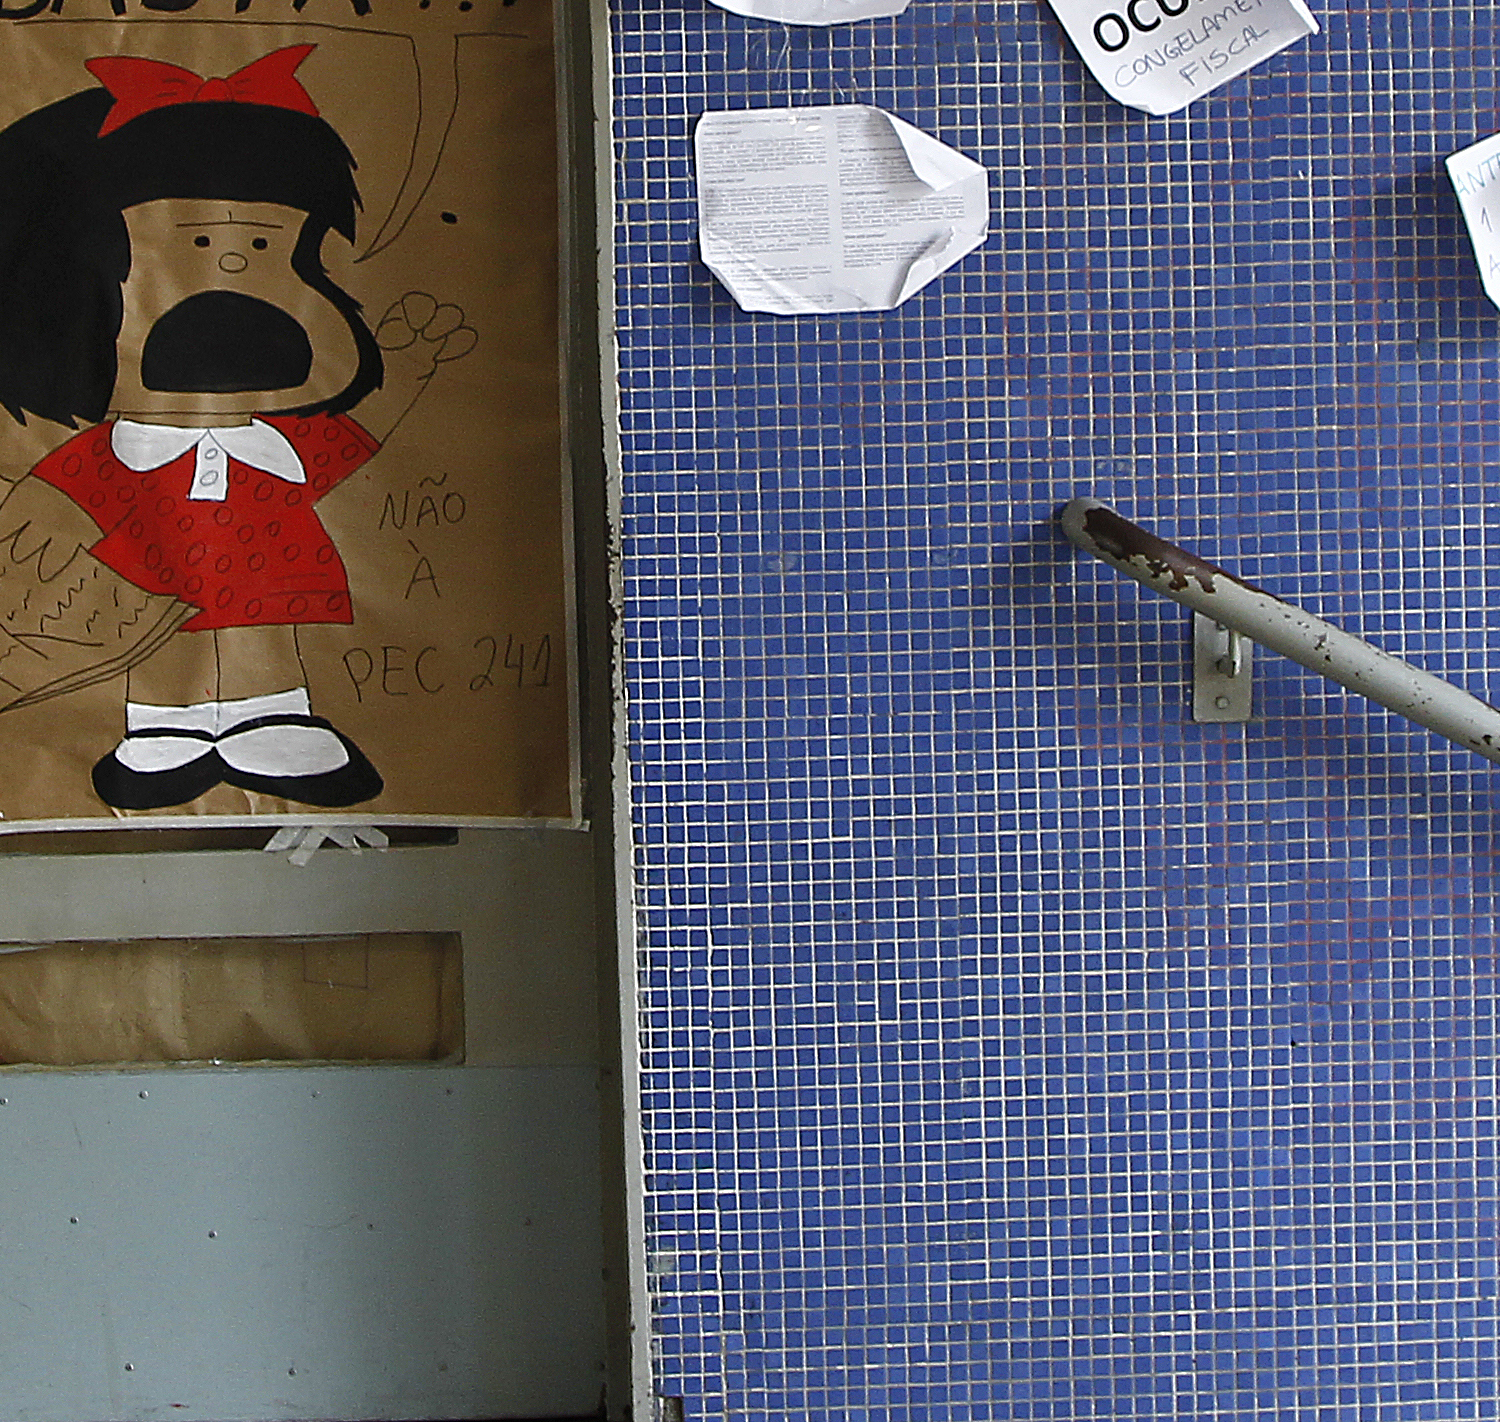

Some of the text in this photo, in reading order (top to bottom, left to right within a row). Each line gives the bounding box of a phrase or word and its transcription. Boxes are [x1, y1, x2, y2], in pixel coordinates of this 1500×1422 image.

[1178, 24, 1270, 87] FISCAL
[378, 472, 467, 533] NÃO
[342, 633, 553, 704] PEC 241
